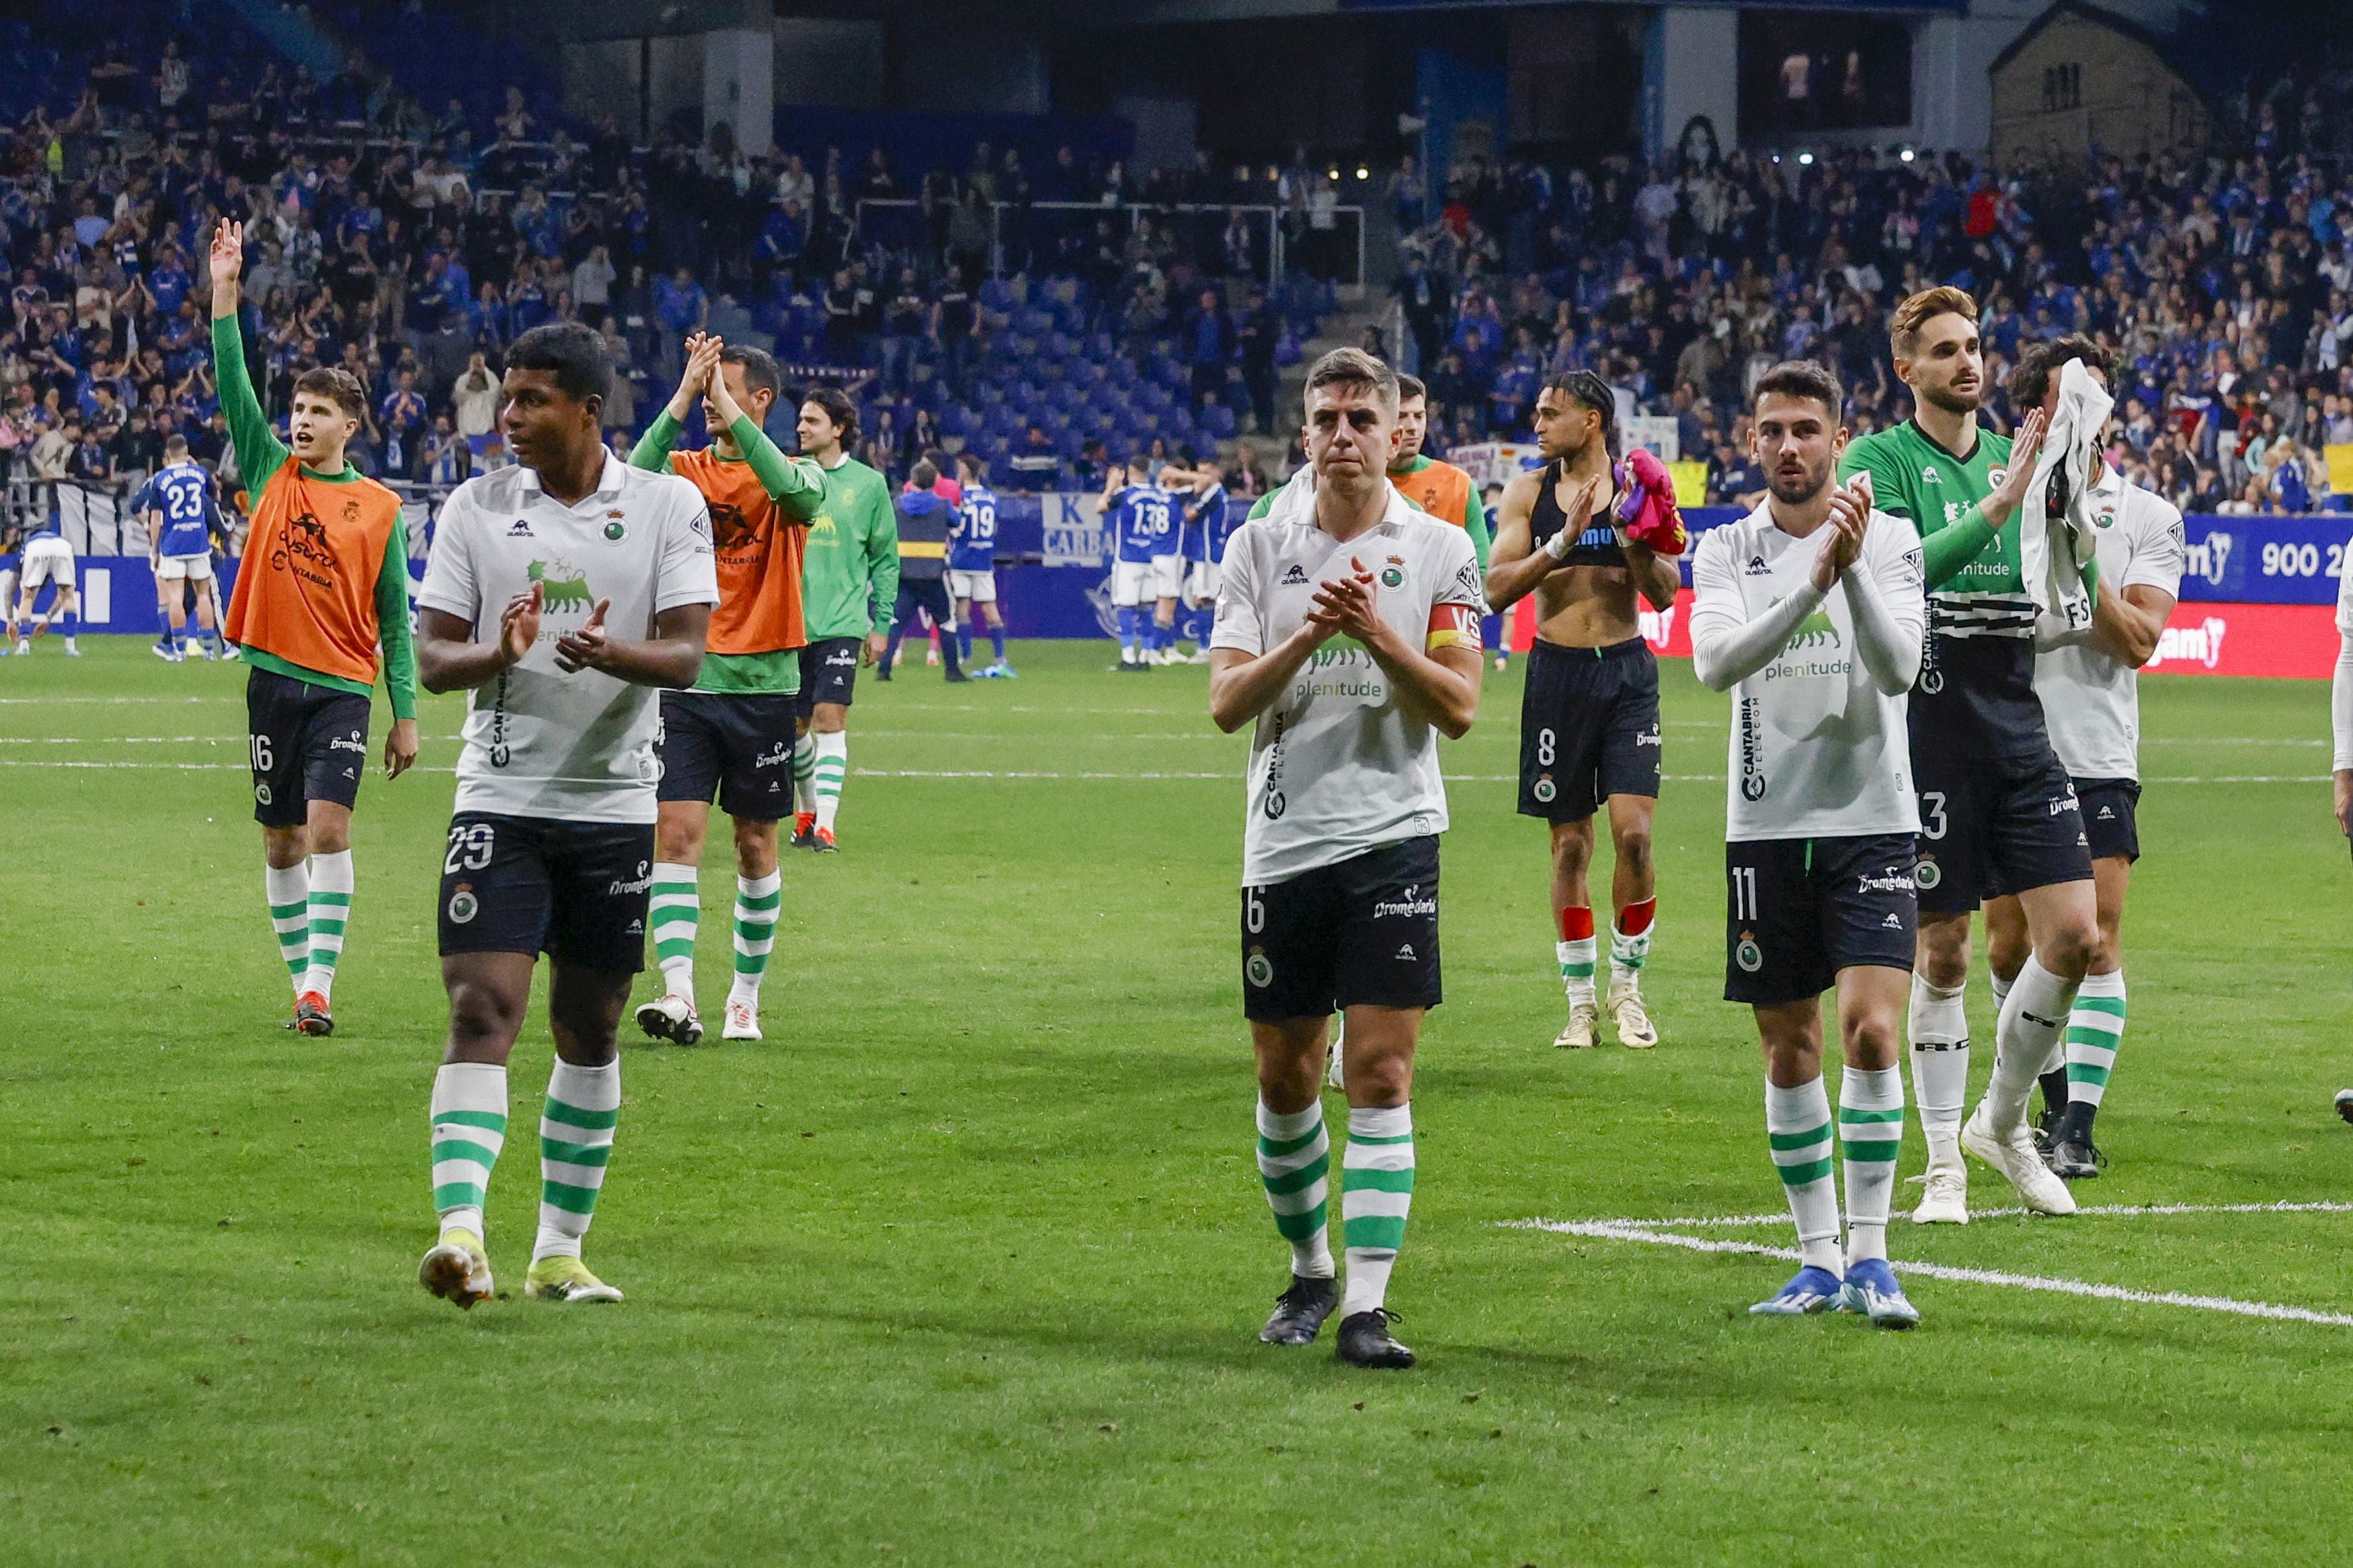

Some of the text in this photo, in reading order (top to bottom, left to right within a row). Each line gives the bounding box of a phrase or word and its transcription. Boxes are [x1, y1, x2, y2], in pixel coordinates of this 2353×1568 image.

[167, 482, 202, 520] 23
[963, 503, 995, 539] 19
[1958, 561, 2010, 576] nitude
[2262, 542, 2319, 577] 900
[2324, 542, 2345, 578] 2
[1296, 679, 1382, 700] plenitude
[1765, 659, 1852, 682] plenitude
[250, 734, 274, 772] 16
[1538, 728, 1556, 767] 8
[1741, 698, 1754, 776] CANTABRIA
[1753, 698, 1762, 774] TELECOM
[1915, 791, 1948, 840] 3
[444, 823, 495, 875] 29
[1247, 886, 1265, 934] 6
[1732, 866, 1757, 921] 11
